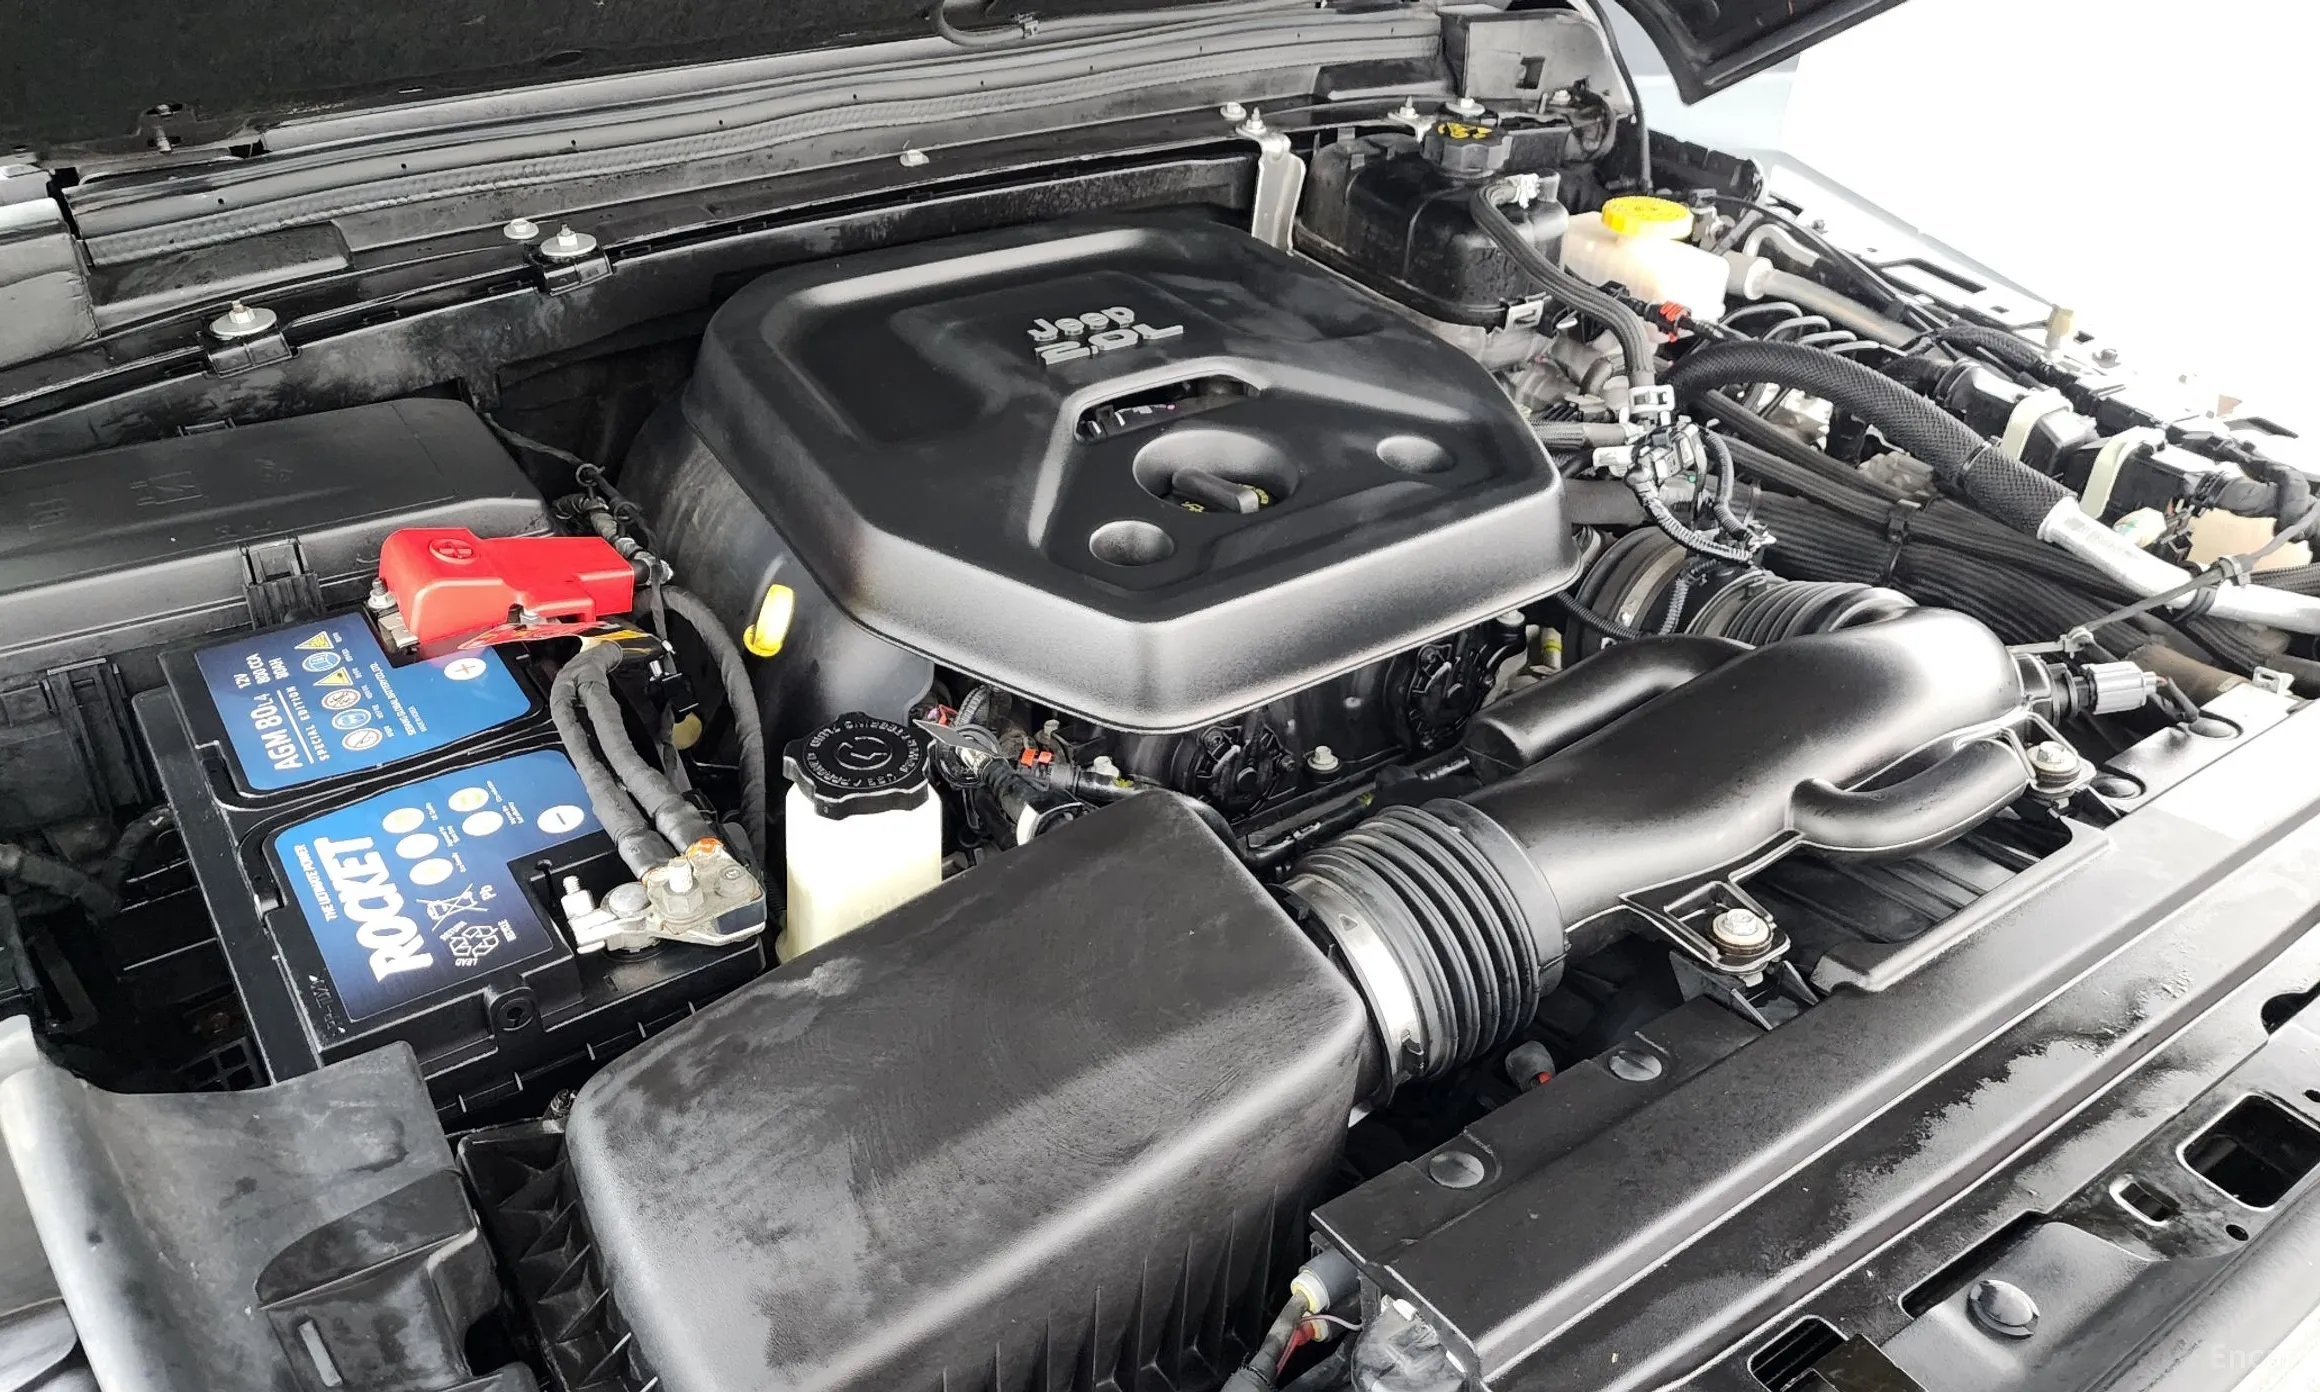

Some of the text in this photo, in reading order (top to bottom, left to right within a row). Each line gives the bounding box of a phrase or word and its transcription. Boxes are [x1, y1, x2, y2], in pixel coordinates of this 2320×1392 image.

[1026, 306, 1135, 342] Jeep
[1034, 323, 1184, 368] 2.0L
[246, 654, 264, 669] CCA
[234, 674, 251, 689] 12V
[286, 686, 330, 761] SPECIAL EDITION
[261, 729, 303, 769] AGM
[313, 836, 433, 983] ROCKET
[454, 957, 478, 967] LEAD
